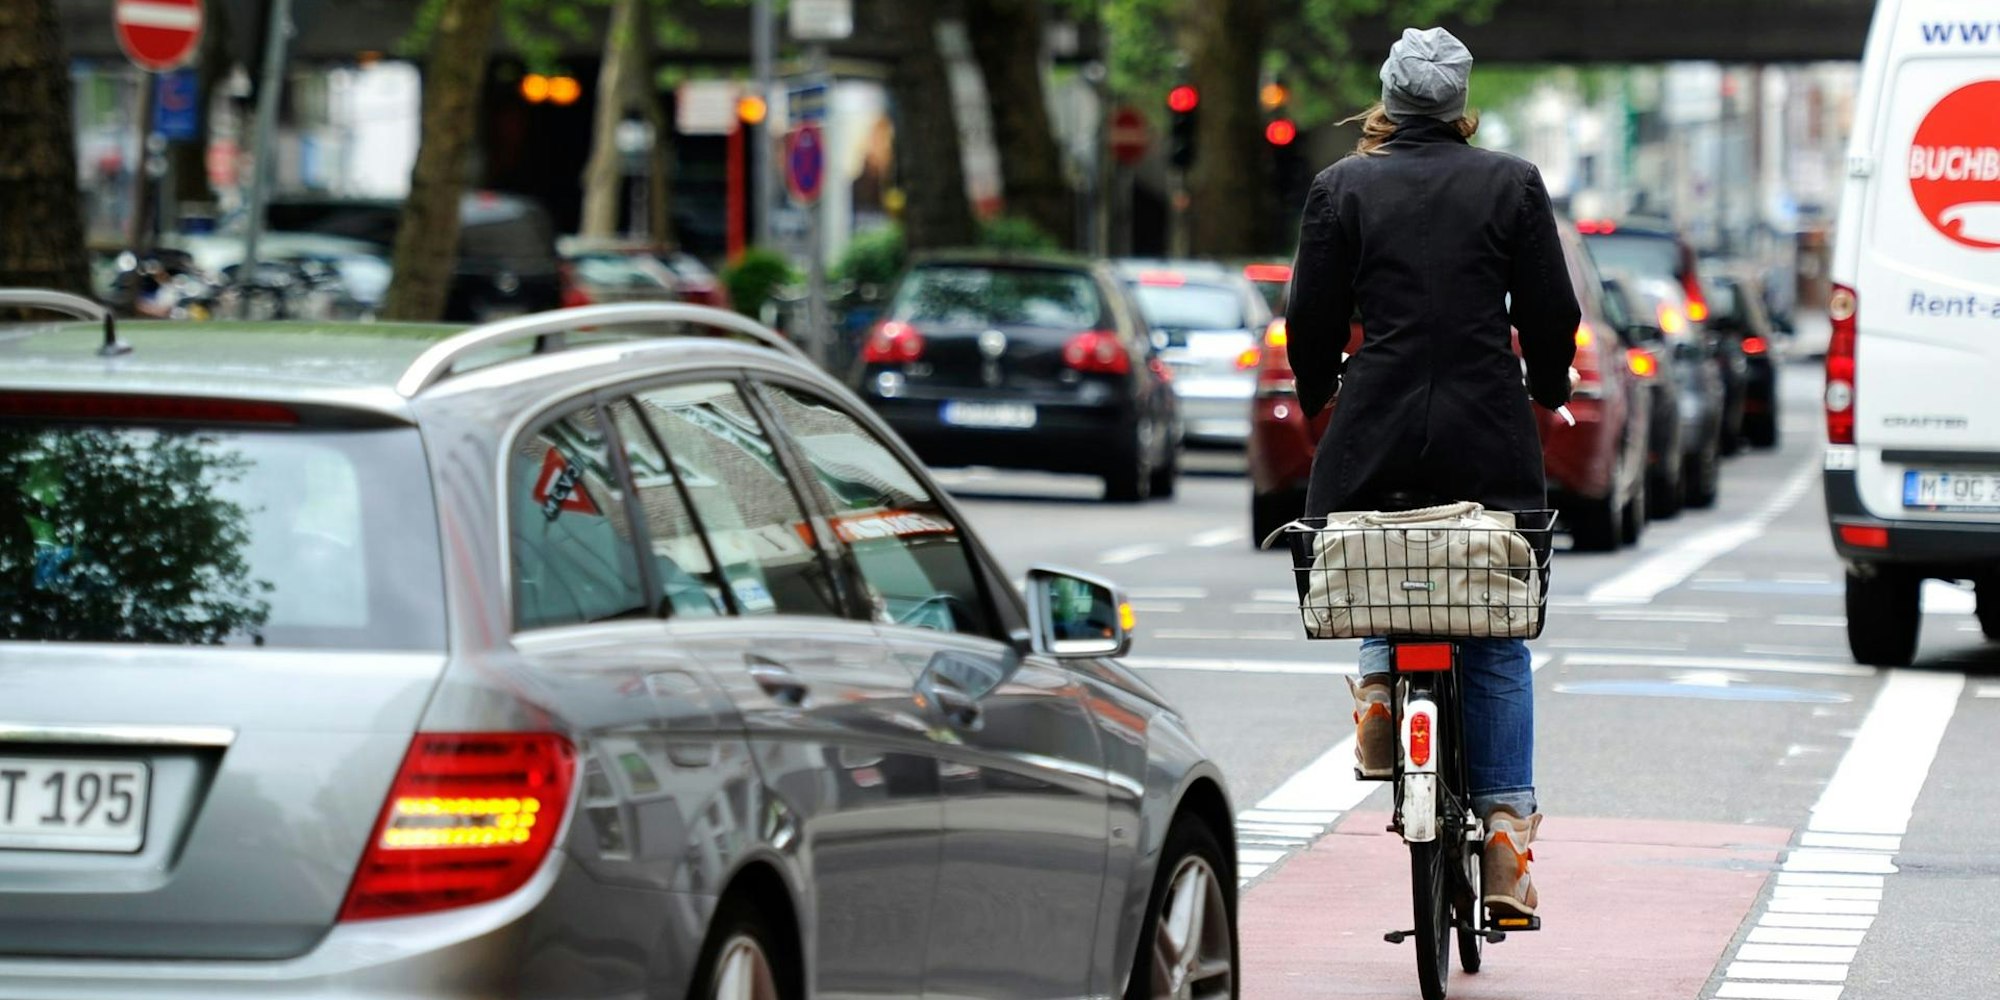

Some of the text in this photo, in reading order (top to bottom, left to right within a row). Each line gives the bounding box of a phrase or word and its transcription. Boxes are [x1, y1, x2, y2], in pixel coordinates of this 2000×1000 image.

[1921, 22, 2000, 43] ww
[1909, 144, 2000, 181] BUCHB
[1921, 476, 1937, 502] M
[0, 769, 135, 826] T 195
